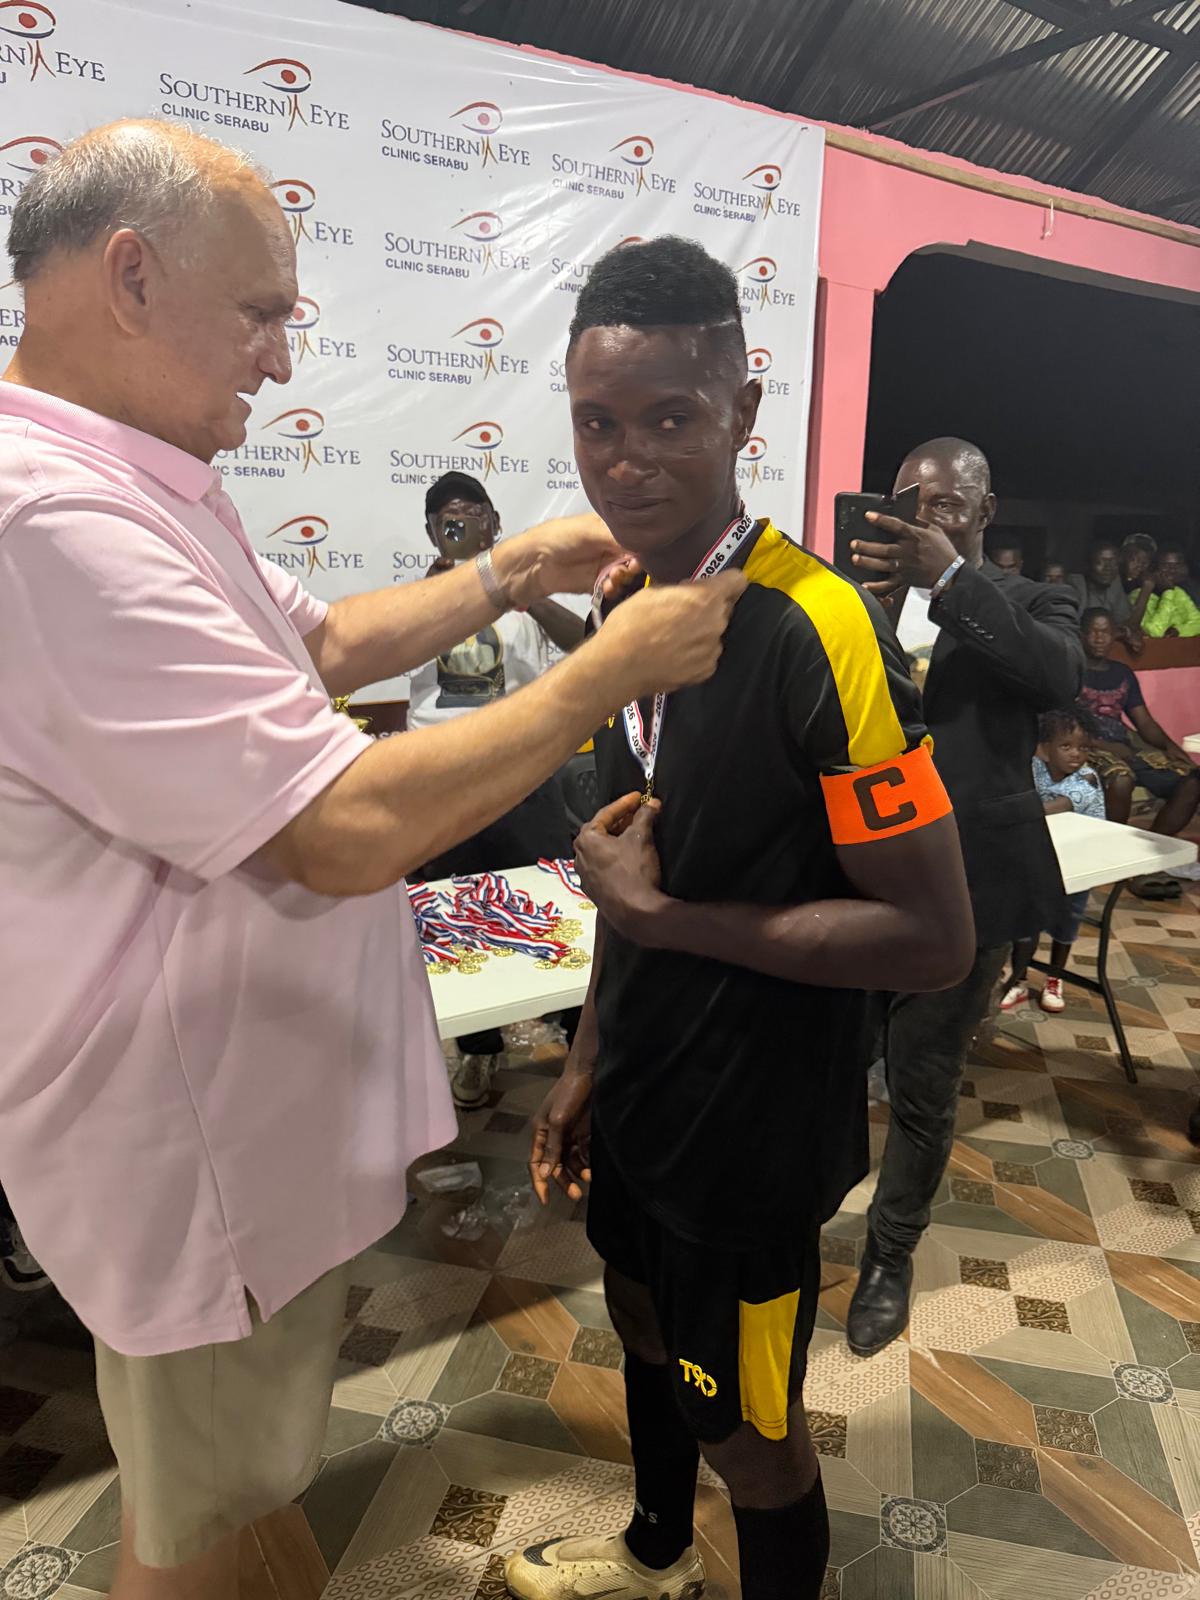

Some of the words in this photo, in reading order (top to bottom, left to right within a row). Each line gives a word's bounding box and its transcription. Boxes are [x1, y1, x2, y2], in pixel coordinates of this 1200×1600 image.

[55, 52, 106, 82] EYE
[158, 73, 287, 117] SOUTHERN
[309, 104, 351, 130] EYE
[161, 102, 211, 123] CLINIC
[214, 112, 270, 133] SERABU
[381, 118, 480, 156] SOUTHERN
[498, 144, 531, 167] EYE
[381, 145, 422, 164] CLINIC
[423, 152, 469, 171] SERABU
[551, 153, 635, 186] SOUTHERN
[651, 173, 677, 194] EYE
[586, 184, 625, 200] SERABU
[693, 182, 765, 211] SOUTHERN
[777, 197, 801, 217] EYE
[693, 203, 721, 219] CLINIC
[723, 208, 757, 224] SERABU
[314, 221, 354, 245] EYE
[384, 232, 482, 264] SOUTHERN
[499, 249, 531, 272] EYE
[385, 258, 424, 272] CLINIC
[426, 263, 470, 279] SERABU
[772, 289, 796, 307] EYE
[318, 337, 357, 358] EYE
[387, 343, 483, 369] SOUTHERN
[500, 355, 530, 375] EYE
[388, 368, 427, 382] CLINIC
[429, 371, 472, 385] SERABU
[767, 379, 790, 396] EYE
[323, 446, 361, 466] EYE
[390, 450, 483, 471] SOUTHERN
[500, 456, 529, 473] EYE
[234, 466, 286, 478] SERABU
[391, 473, 428, 485] CLINIC
[762, 465, 785, 482] EYE
[546, 480, 580, 490] CLINIC
[731, 514, 753, 542] 2026
[327, 550, 365, 569] EYE
[852, 766, 918, 831] C
